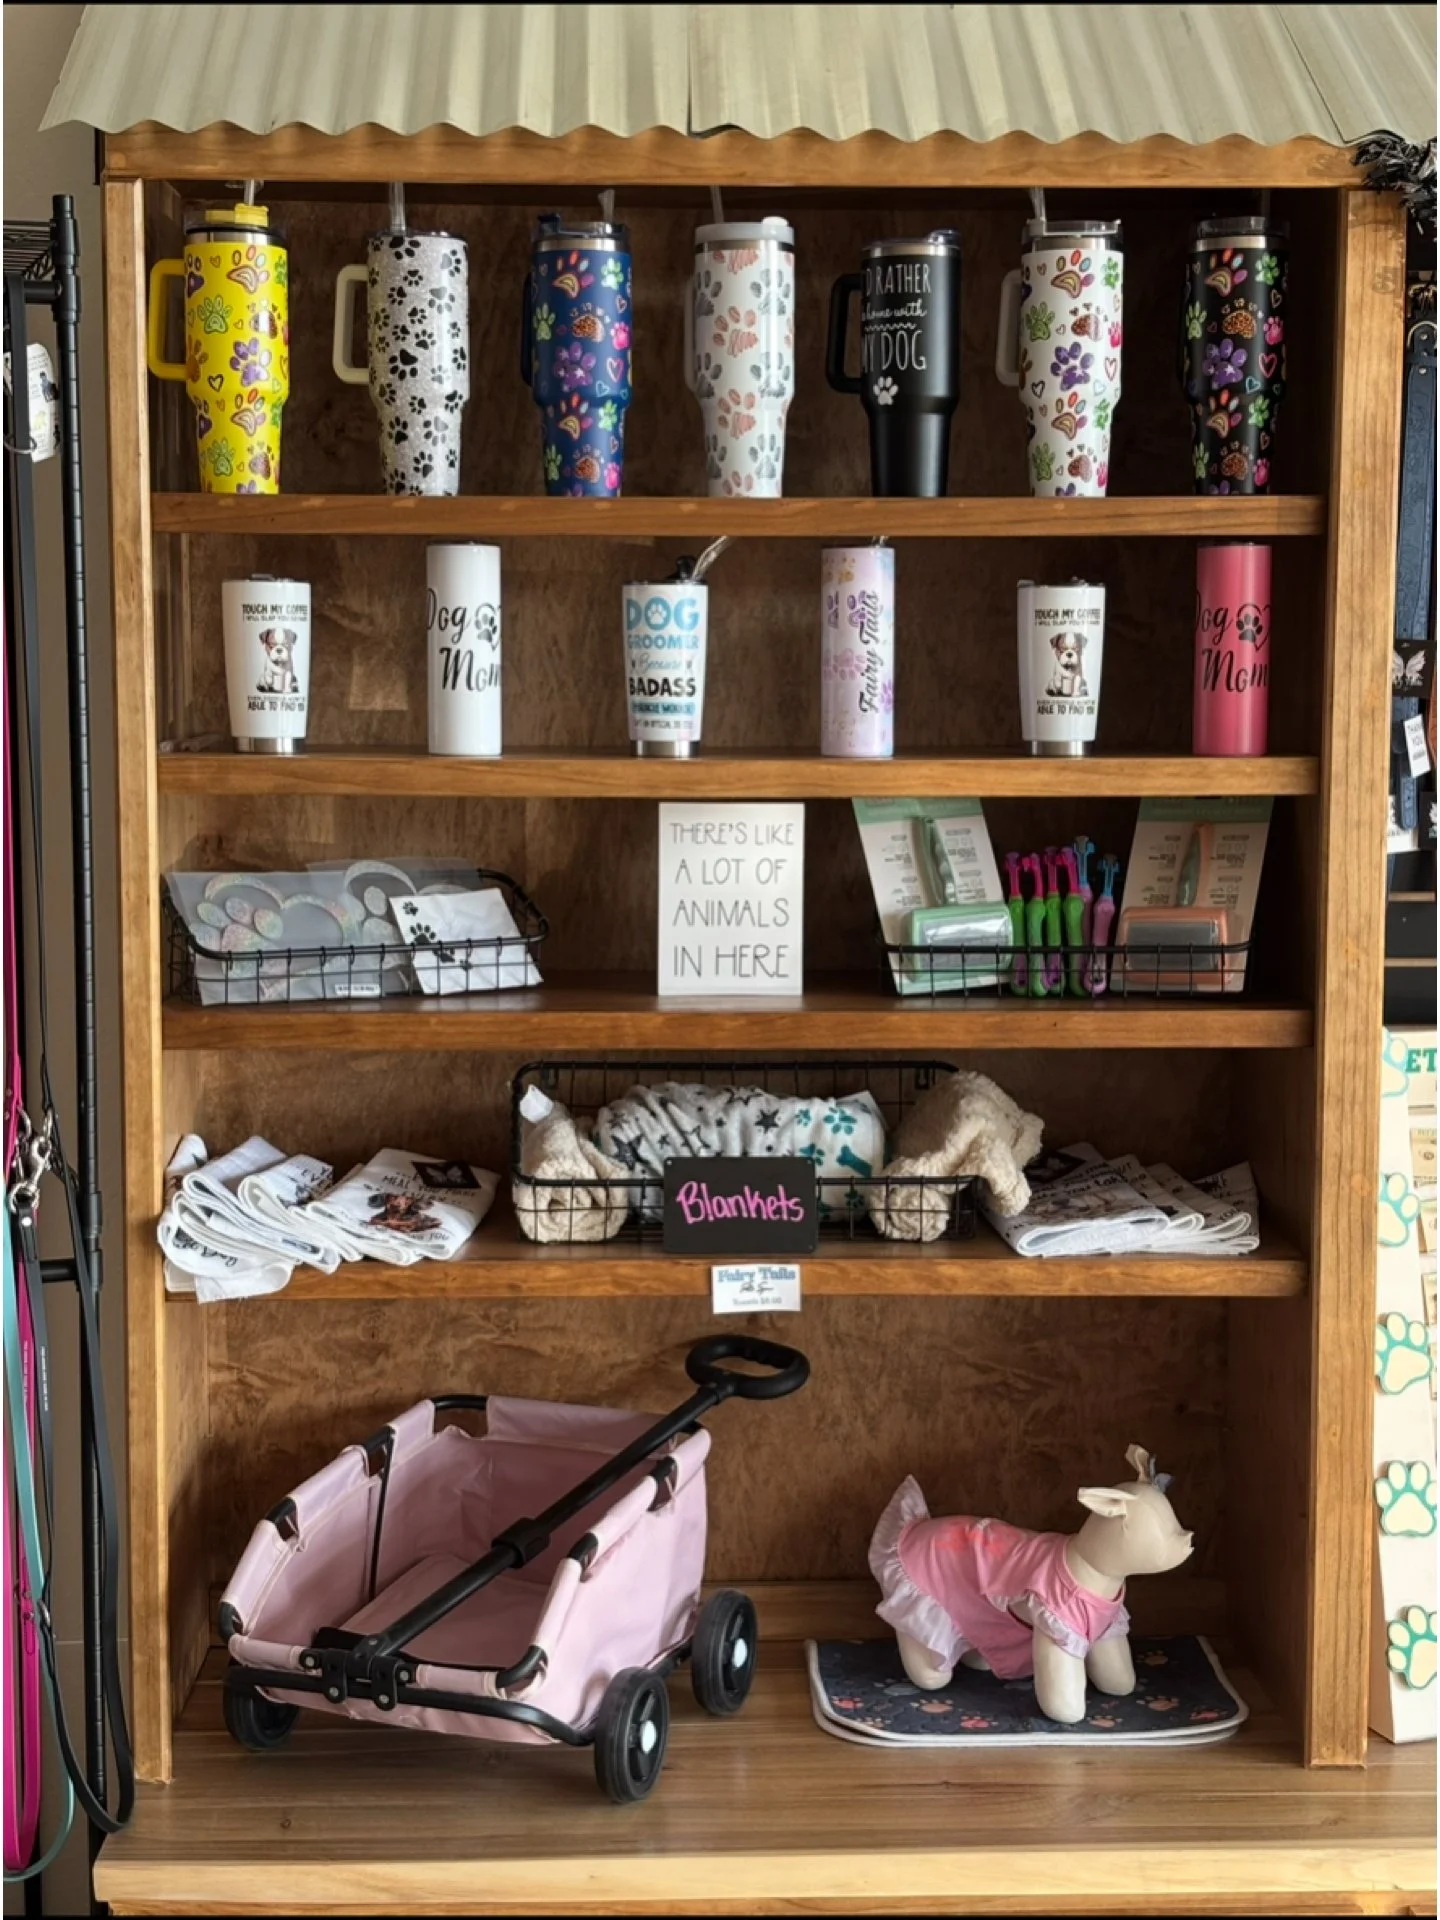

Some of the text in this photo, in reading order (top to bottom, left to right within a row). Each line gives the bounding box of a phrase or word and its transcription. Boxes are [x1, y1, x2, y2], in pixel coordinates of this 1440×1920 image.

[875, 263, 932, 295] RATHER
[880, 330, 928, 371] DOG
[242, 604, 268, 615] TOUCH
[270, 604, 283, 614] MY
[626, 597, 700, 631] DOG
[1034, 608, 1059, 620] TOUCH
[1062, 608, 1075, 619] MY
[626, 635, 699, 649] GROOMER
[859, 588, 884, 714] Fairy Tails
[629, 676, 697, 698] BADASS
[670, 821, 794, 845] THERE'S LIKE
[675, 857, 788, 885] A LOT OF
[672, 897, 790, 927] ANIMALS
[673, 943, 789, 978] IN HERE
[676, 1180, 805, 1224] Blankets
